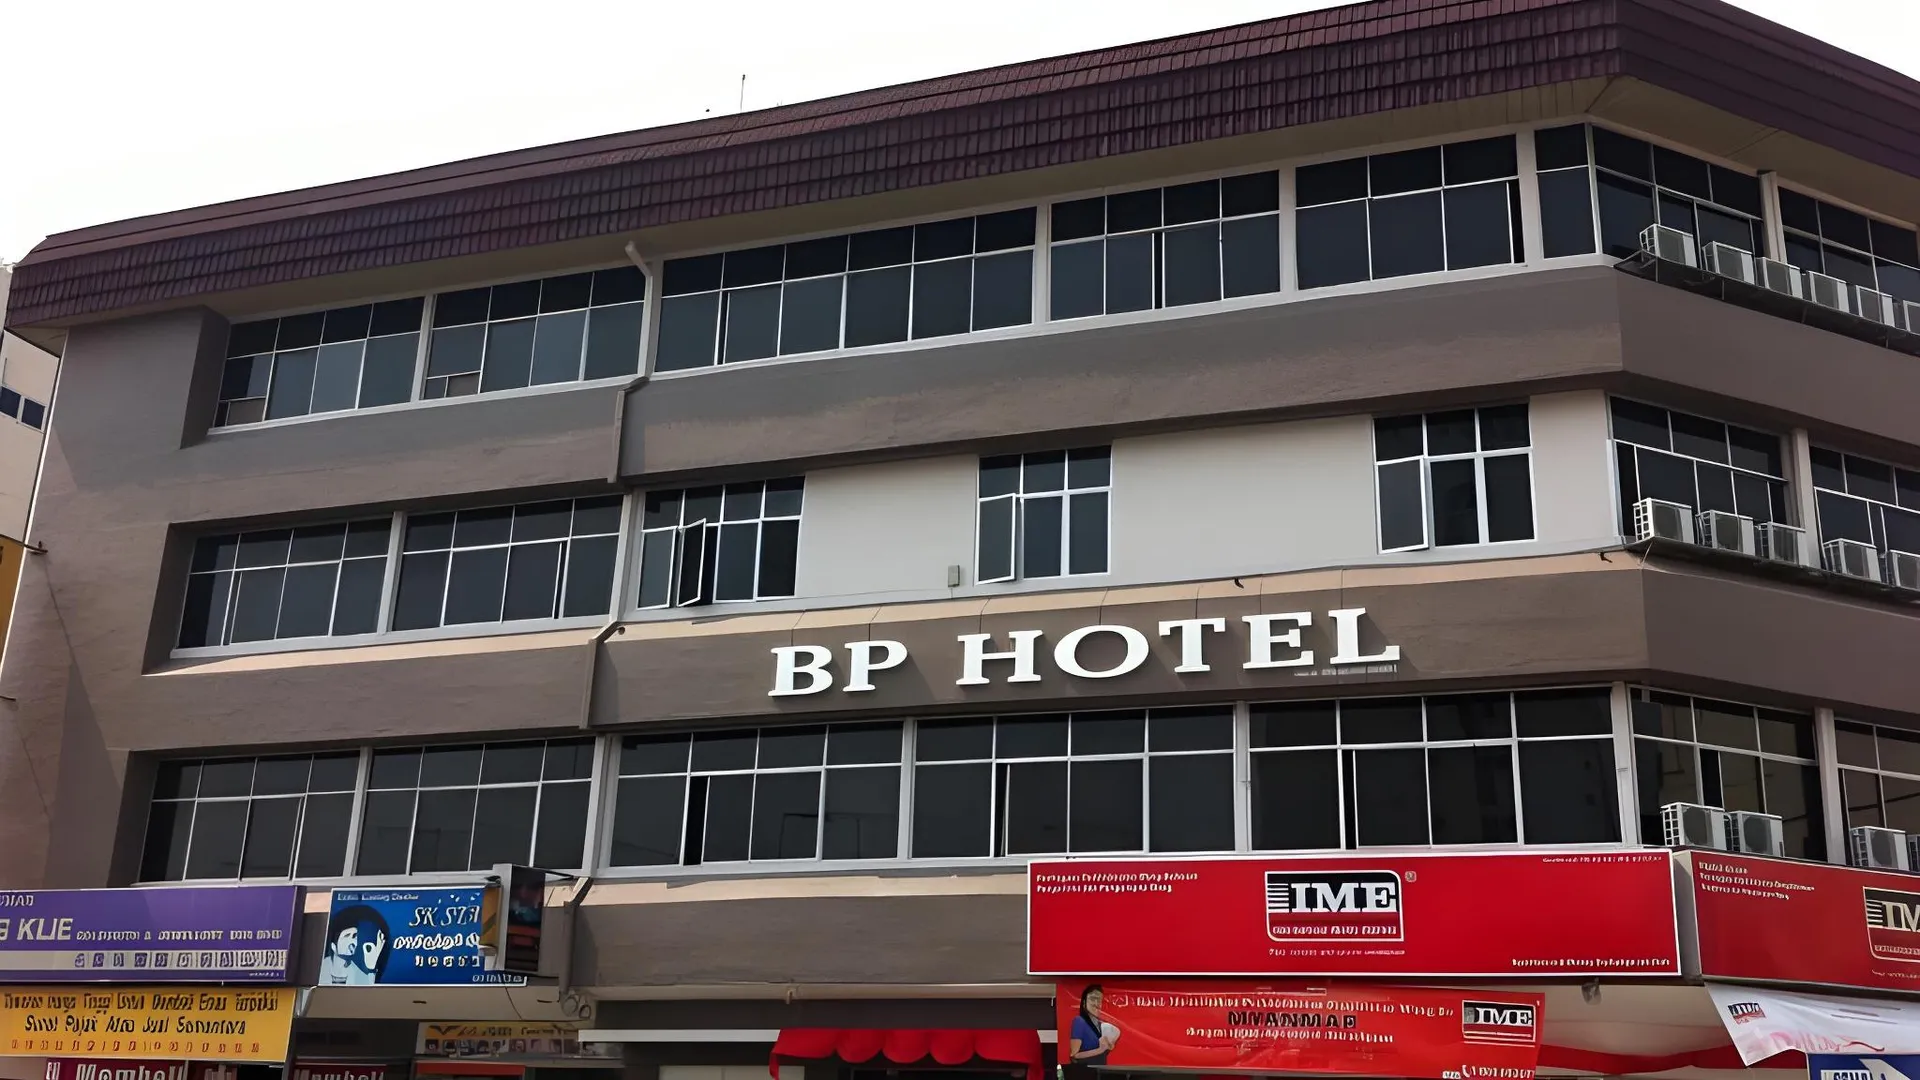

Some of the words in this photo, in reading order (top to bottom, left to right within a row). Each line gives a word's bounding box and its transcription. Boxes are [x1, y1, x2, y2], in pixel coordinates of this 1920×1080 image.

[768, 639, 908, 697] BP
[956, 607, 1401, 686] HOTEL
[1291, 882, 1397, 913] IME
